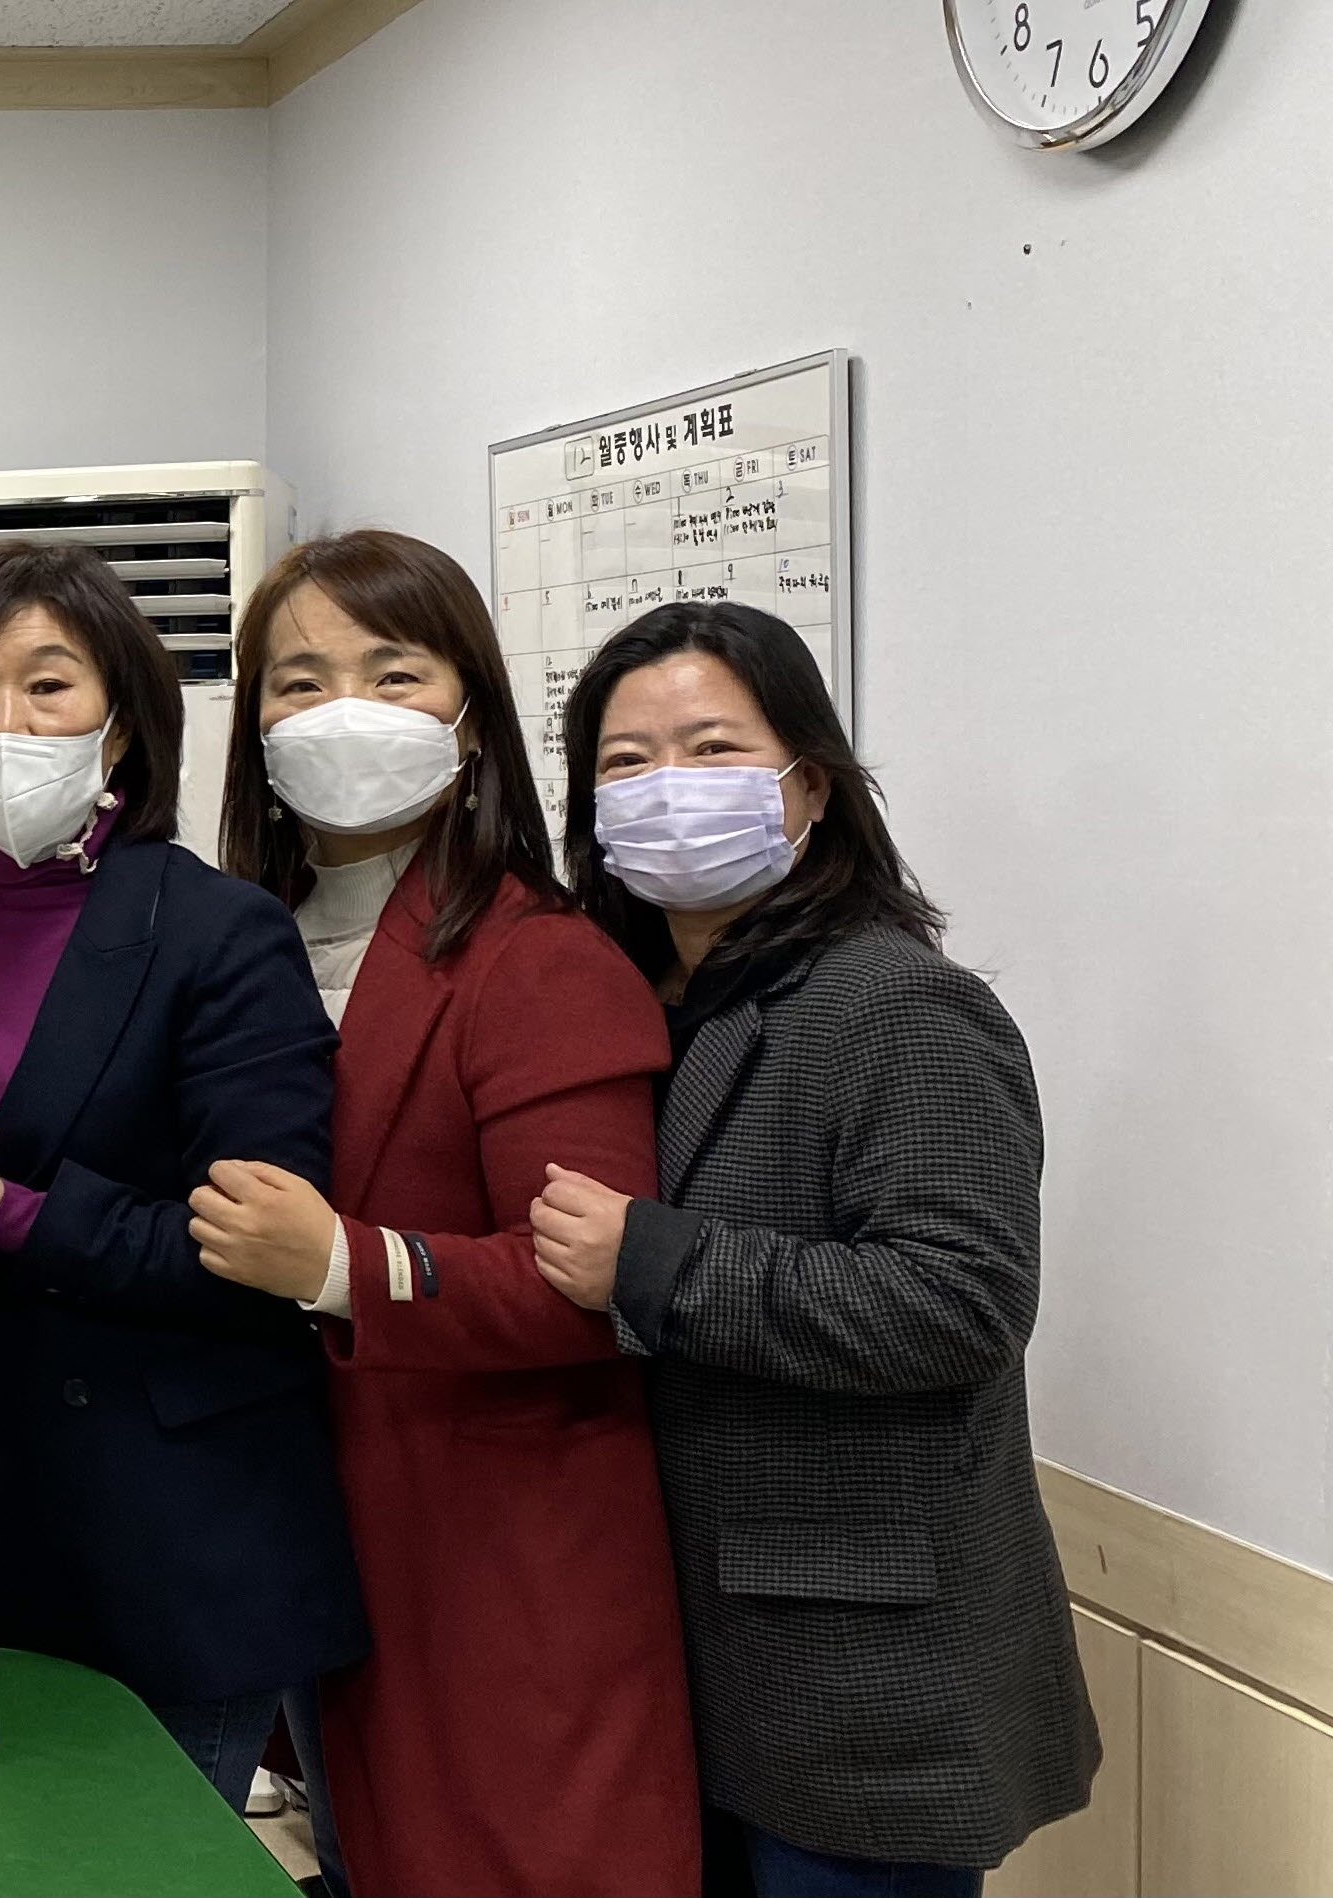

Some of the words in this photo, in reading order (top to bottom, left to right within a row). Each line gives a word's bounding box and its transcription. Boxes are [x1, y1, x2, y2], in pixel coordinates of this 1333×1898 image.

[1013, 3, 1031, 52] 8
[1046, 39, 1063, 88] 7
[1089, 38, 1109, 88] 6
[598, 421, 661, 468] 월중행사
[664, 423, 677, 451] 및
[683, 404, 734, 446] 계획표
[799, 446, 816, 463] SAT
[747, 459, 759, 473] FRI
[693, 470, 709, 484] THU
[644, 481, 661, 496] WED
[725, 487, 734, 501] 2
[600, 490, 614, 505] TUE
[556, 503, 573, 516] MON
